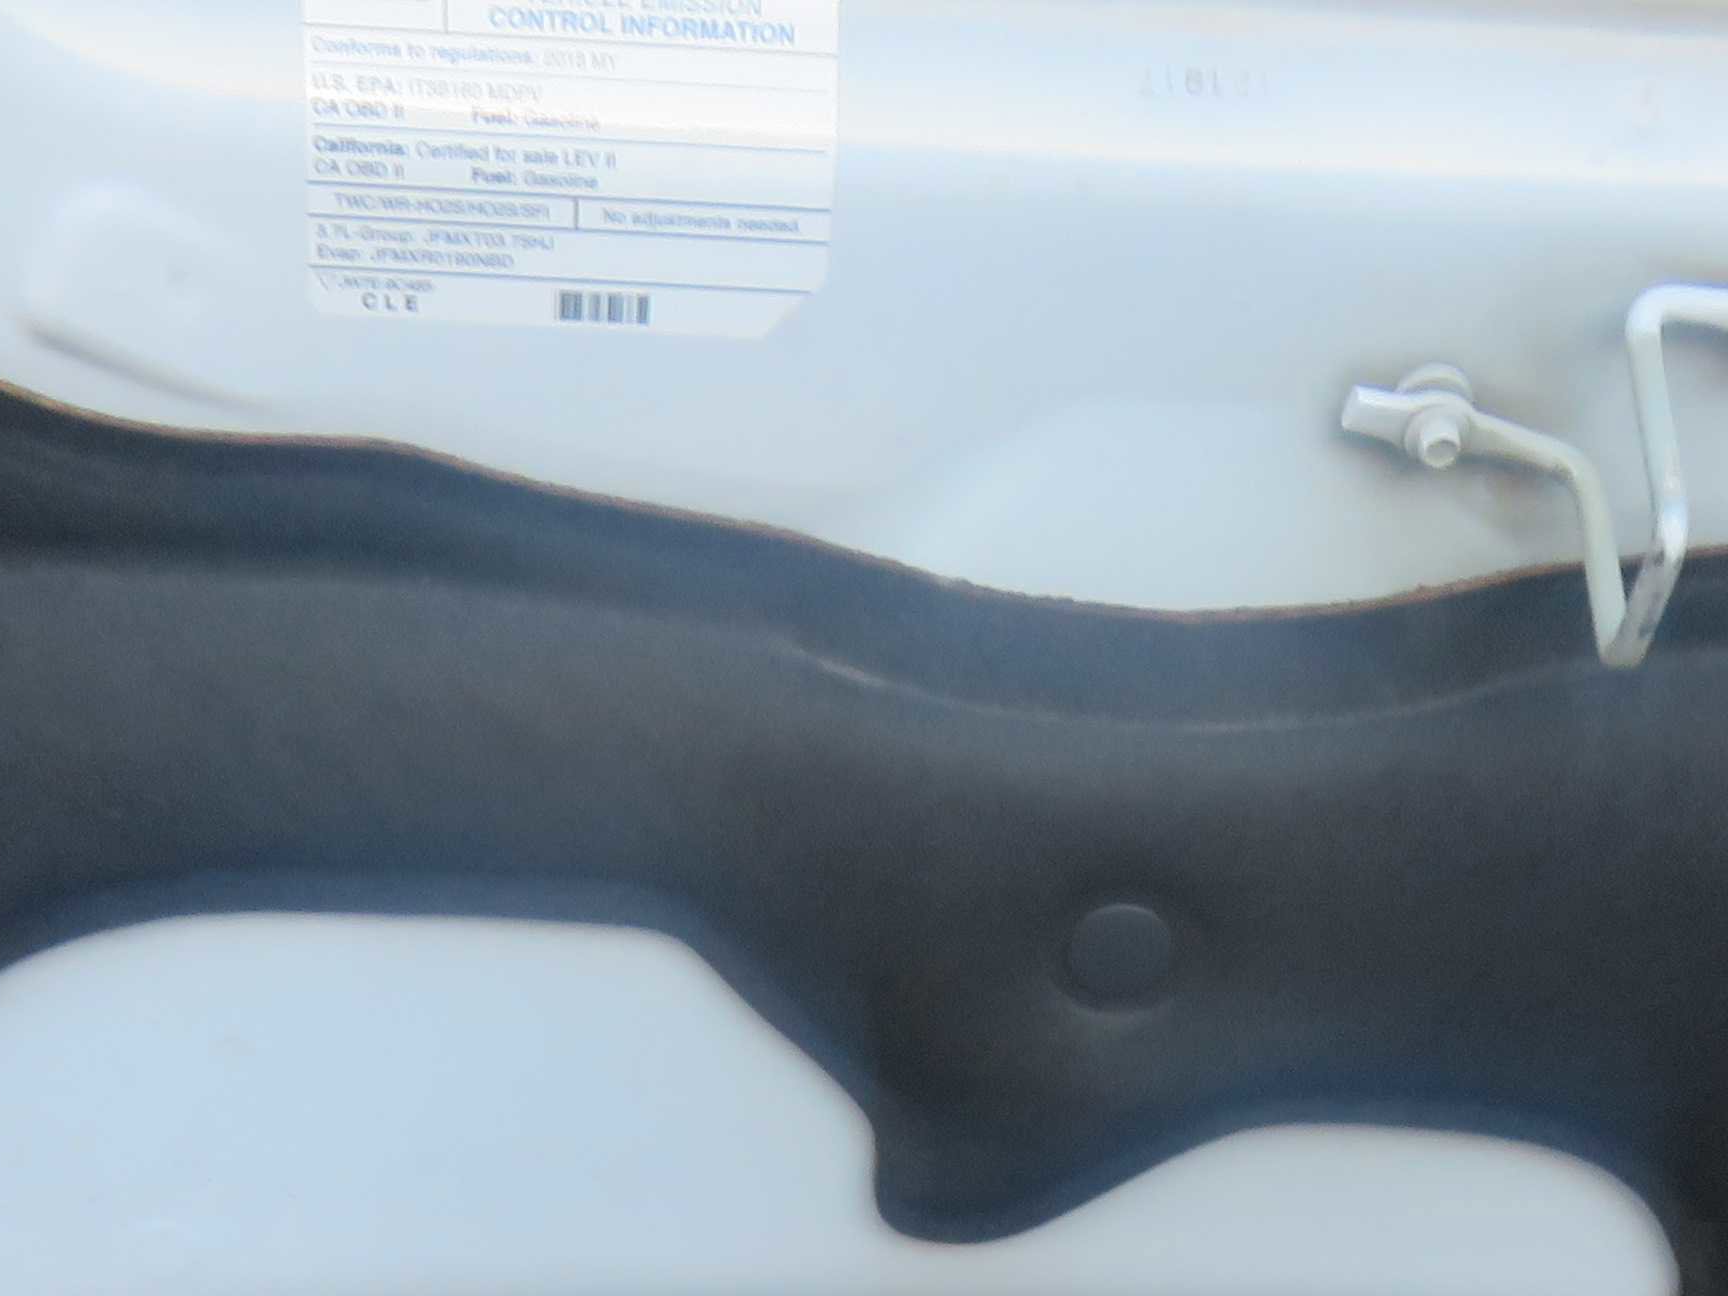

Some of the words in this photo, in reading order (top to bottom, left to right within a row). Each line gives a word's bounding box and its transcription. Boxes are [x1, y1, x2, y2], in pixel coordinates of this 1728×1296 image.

[489, 7, 610, 33] CONTROL
[621, 14, 796, 44] INFORMATION
[312, 36, 402, 57] Conforms
[407, 43, 425, 58] to
[313, 136, 410, 157] California:
[415, 140, 489, 162] Certified
[522, 149, 559, 166] sale
[602, 207, 627, 224] No
